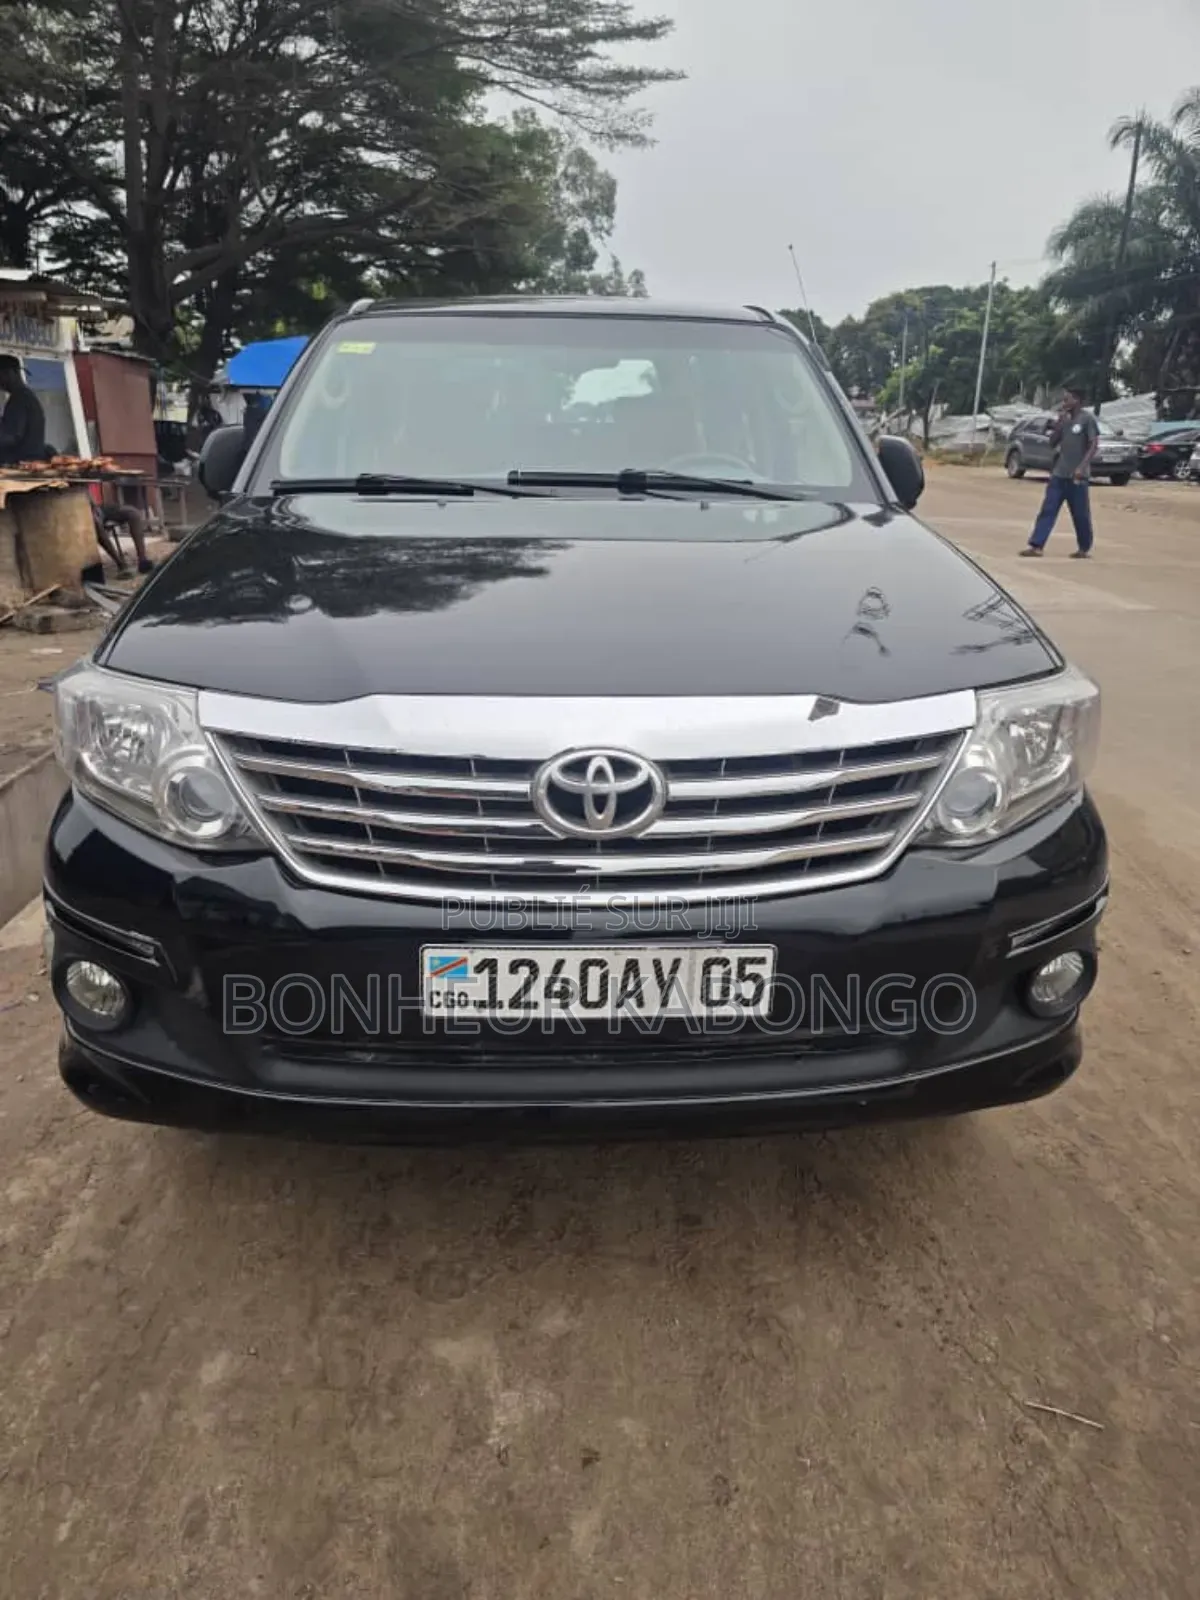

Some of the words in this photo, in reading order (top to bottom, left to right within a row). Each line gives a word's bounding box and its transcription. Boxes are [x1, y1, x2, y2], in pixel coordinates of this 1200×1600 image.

[429, 990, 469, 1008] CGO
[474, 957, 682, 1010] 1240AY
[700, 956, 767, 1008] 05
